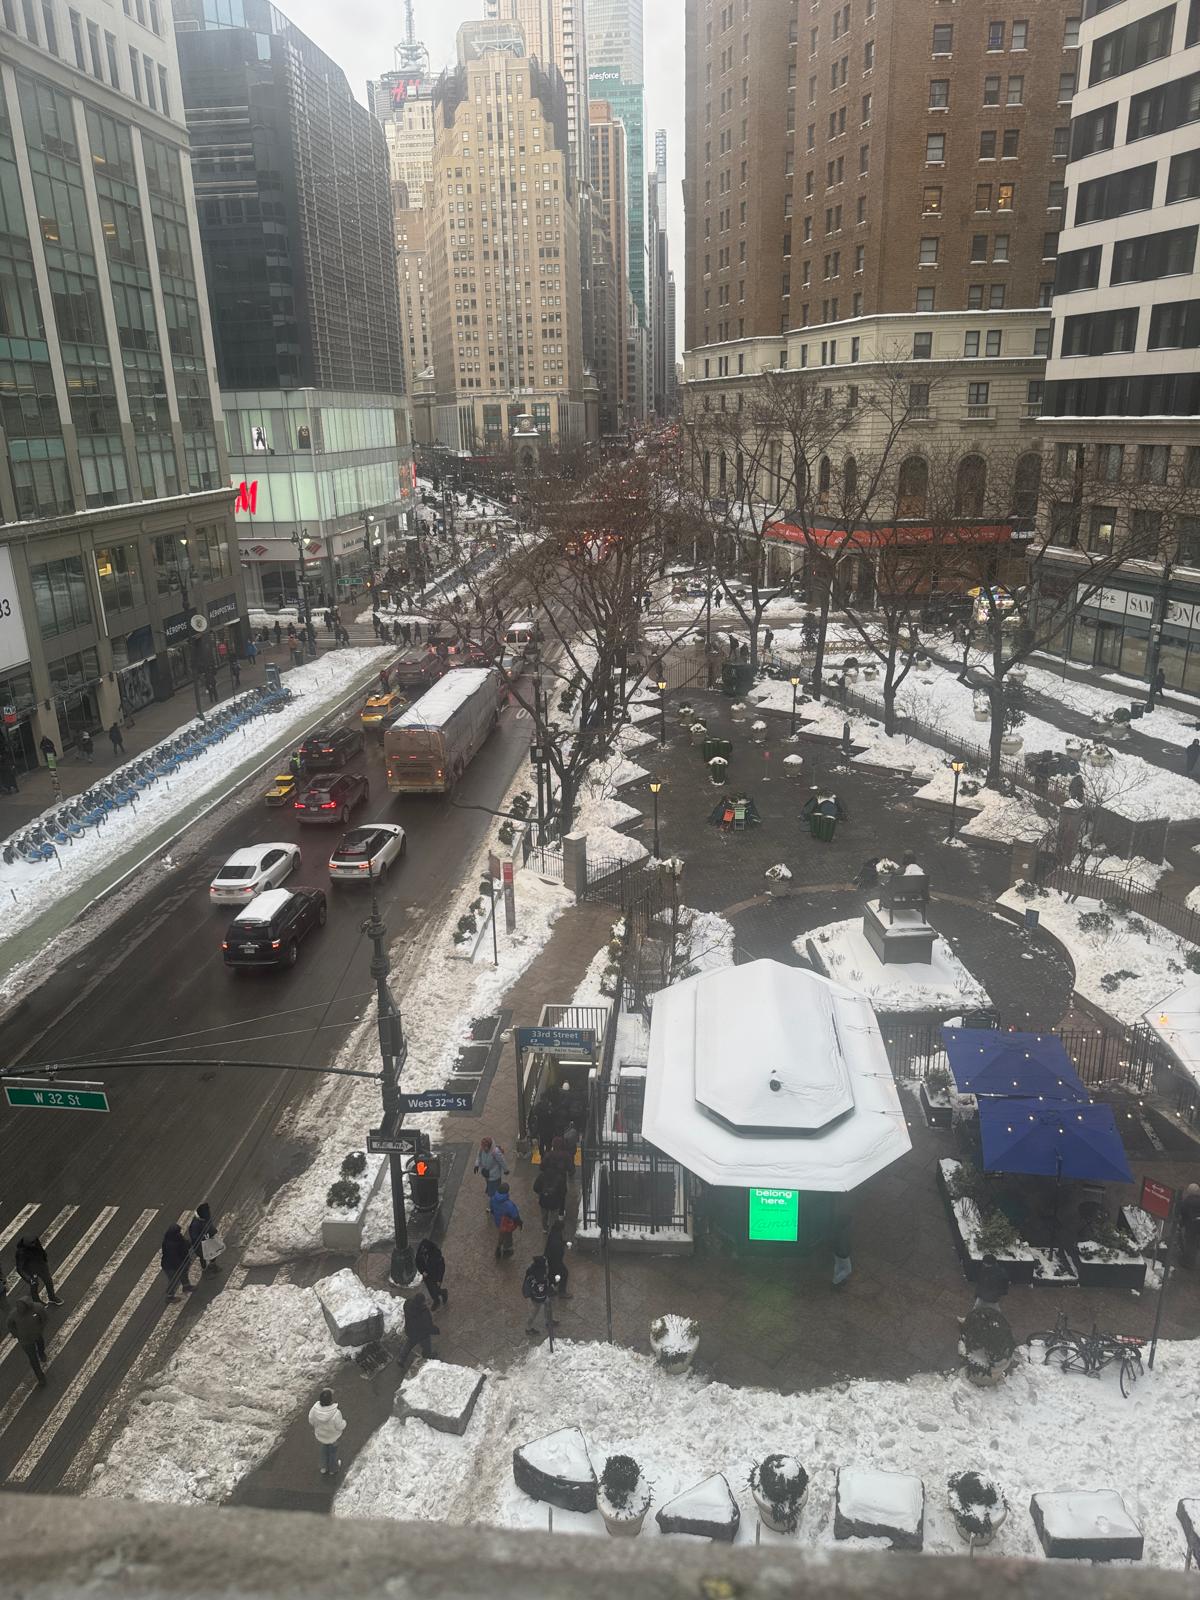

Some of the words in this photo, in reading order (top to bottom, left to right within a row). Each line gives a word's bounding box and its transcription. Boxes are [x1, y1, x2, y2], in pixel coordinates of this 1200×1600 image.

[531, 1030, 551, 1038] 33rd
[553, 1031, 578, 1039] Street
[34, 1092, 43, 1103] W
[48, 1093, 64, 1104] 32
[67, 1094, 81, 1106] St
[408, 1099, 432, 1108] West
[456, 1097, 466, 1106] St
[755, 1189, 792, 1199] belong
